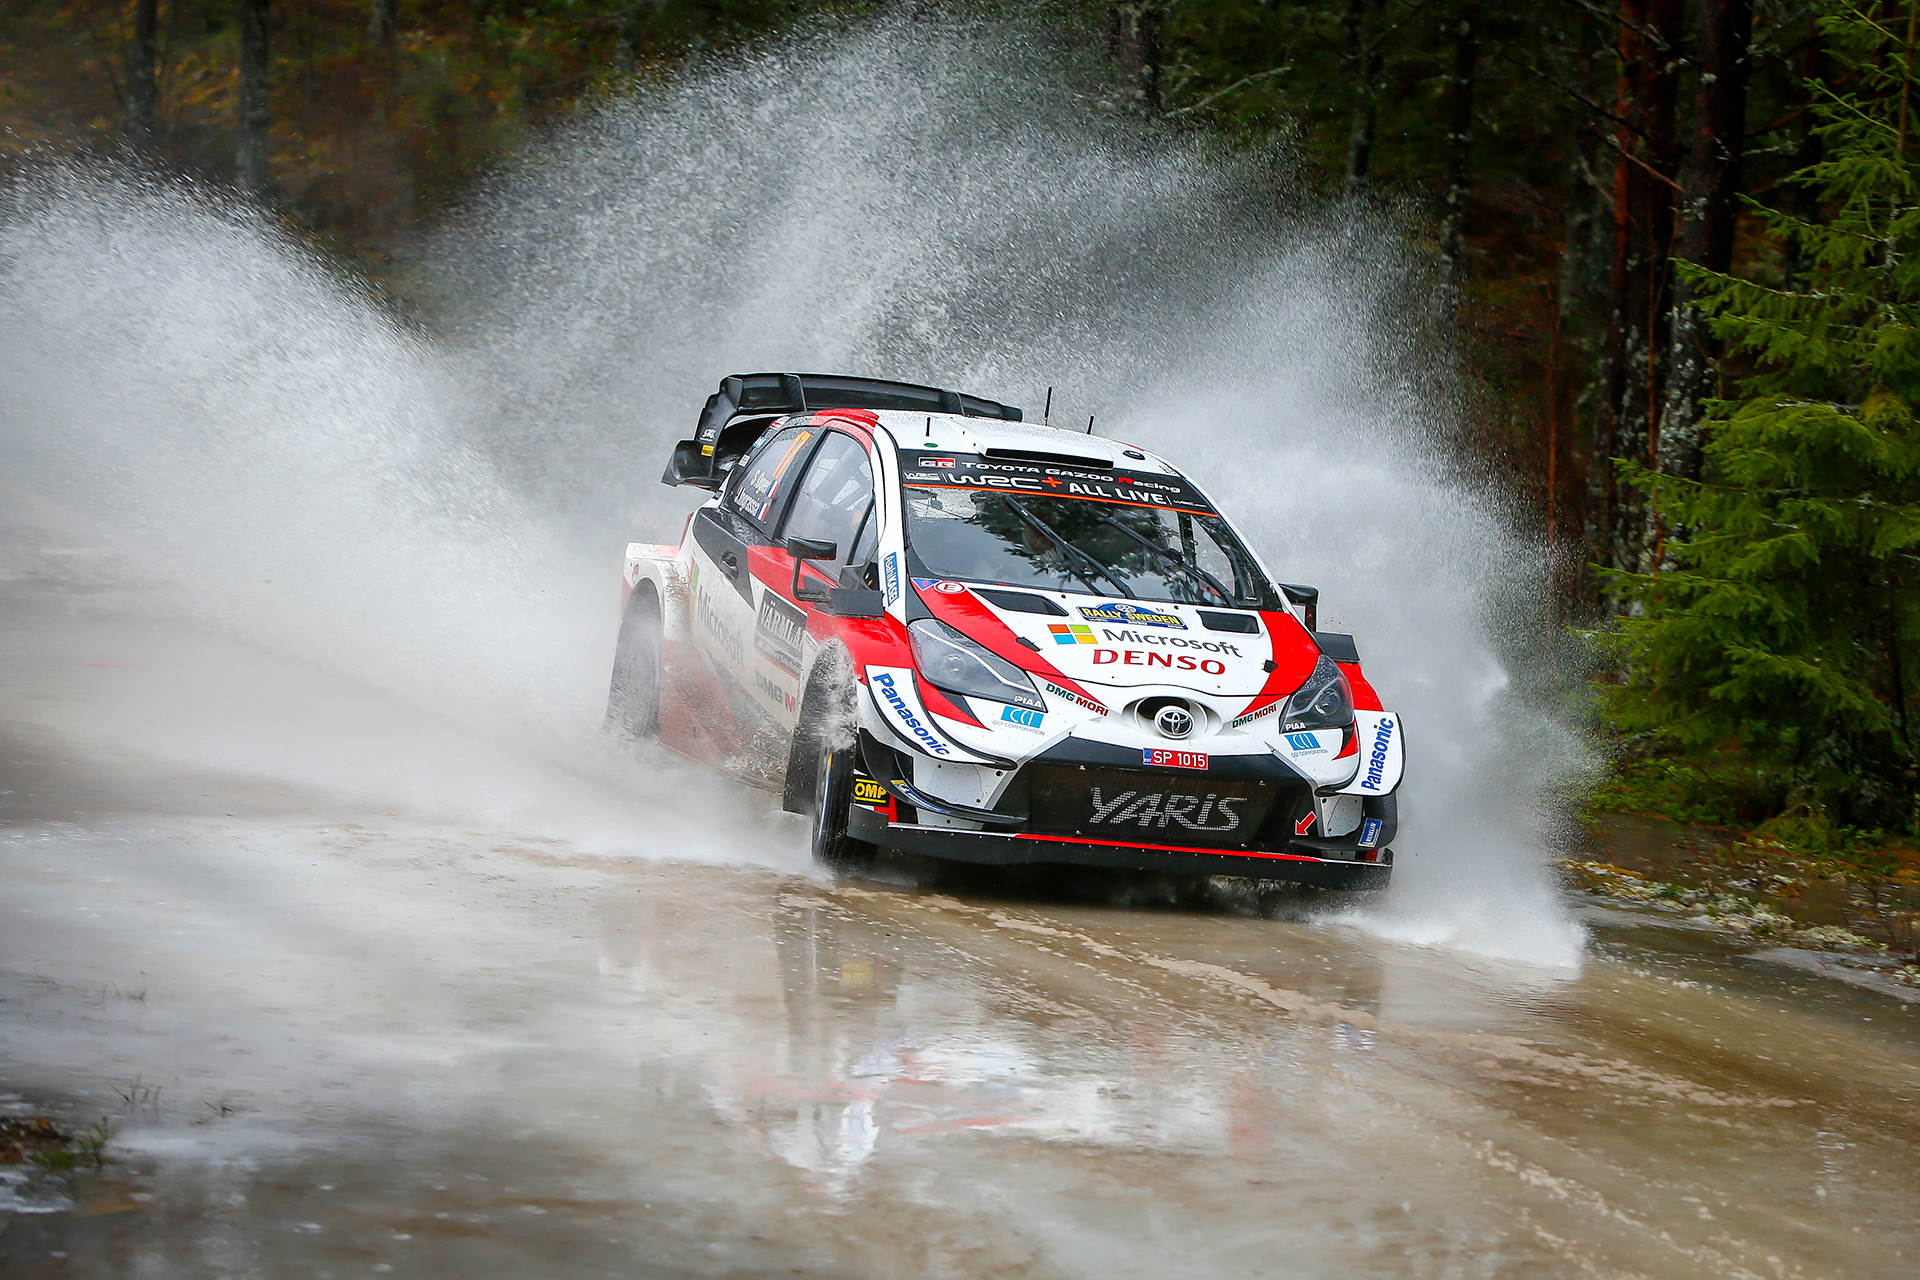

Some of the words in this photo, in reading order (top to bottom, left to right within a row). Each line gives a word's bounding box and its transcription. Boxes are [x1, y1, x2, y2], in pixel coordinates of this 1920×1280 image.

[919, 458, 955, 468] GR
[961, 462, 1041, 474] TOYOTA
[1045, 468, 1114, 482] GAZOO
[1118, 476, 1181, 494] Racing
[1069, 483, 1112, 499] ALL
[1115, 487, 1167, 505] LIVE
[1082, 608, 1121, 619] RALLY
[1125, 612, 1181, 625] SWEDEN
[1102, 629, 1243, 658] Microsoft
[1093, 649, 1226, 675] DENSO
[1013, 695, 1042, 708] PIAA
[1045, 683, 1075, 702] DMG
[1075, 697, 1109, 717] MORI
[873, 673, 950, 756] Panasonic
[1232, 714, 1253, 729] DMG
[1254, 704, 1277, 720] MORI
[1004, 721, 1045, 736] CORPORATION
[1285, 721, 1306, 731] PIAA
[1152, 751, 1173, 764] SP
[1177, 753, 1206, 768] 1015
[1301, 749, 1328, 757] CORPORATION
[1361, 717, 1394, 792] Panasonic
[854, 783, 887, 799] OMP
